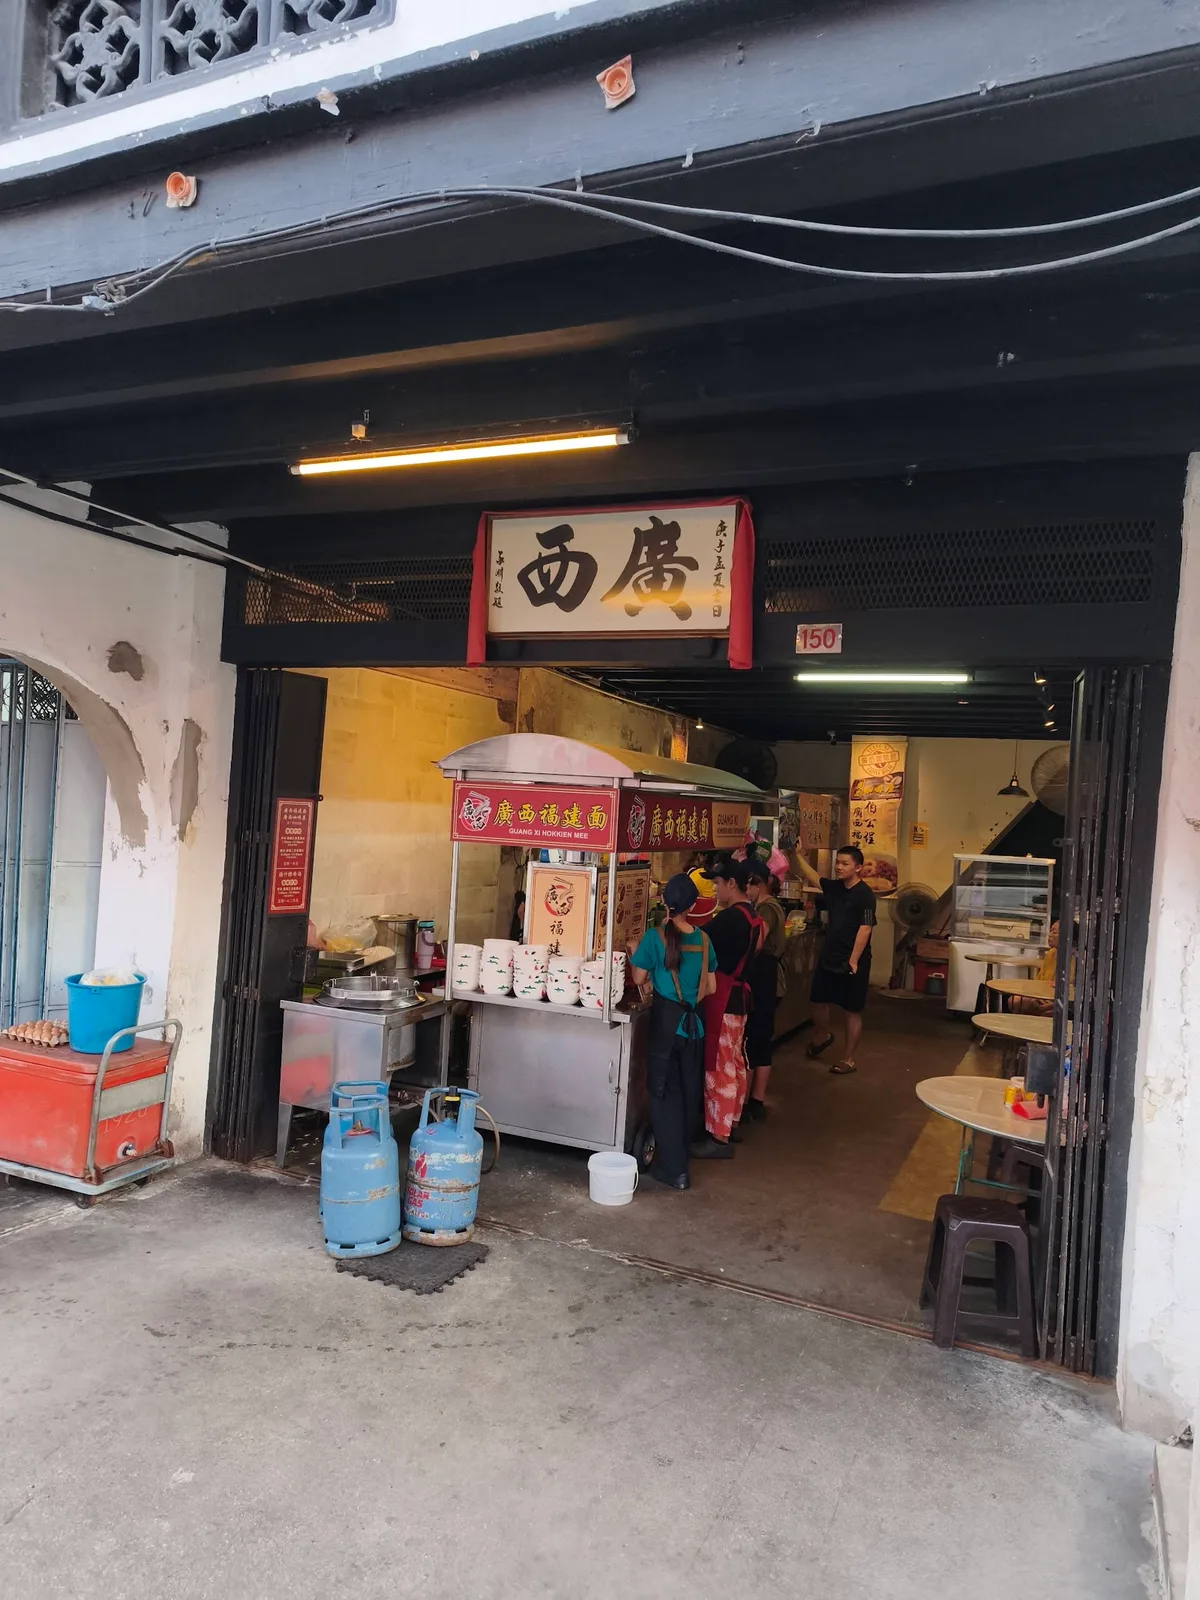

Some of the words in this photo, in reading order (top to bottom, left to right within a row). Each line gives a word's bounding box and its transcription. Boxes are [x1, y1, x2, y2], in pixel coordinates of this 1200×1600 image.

[800, 628, 836, 651] 150
[494, 799, 608, 830] 廣西福建面
[717, 814, 734, 826] GUANG
[508, 827, 533, 836] GUANG
[541, 829, 572, 839] HOKKIEN
[573, 831, 589, 840] MEE
[648, 803, 709, 846] 廣西福建面
[408, 1197, 423, 1208] GAS
